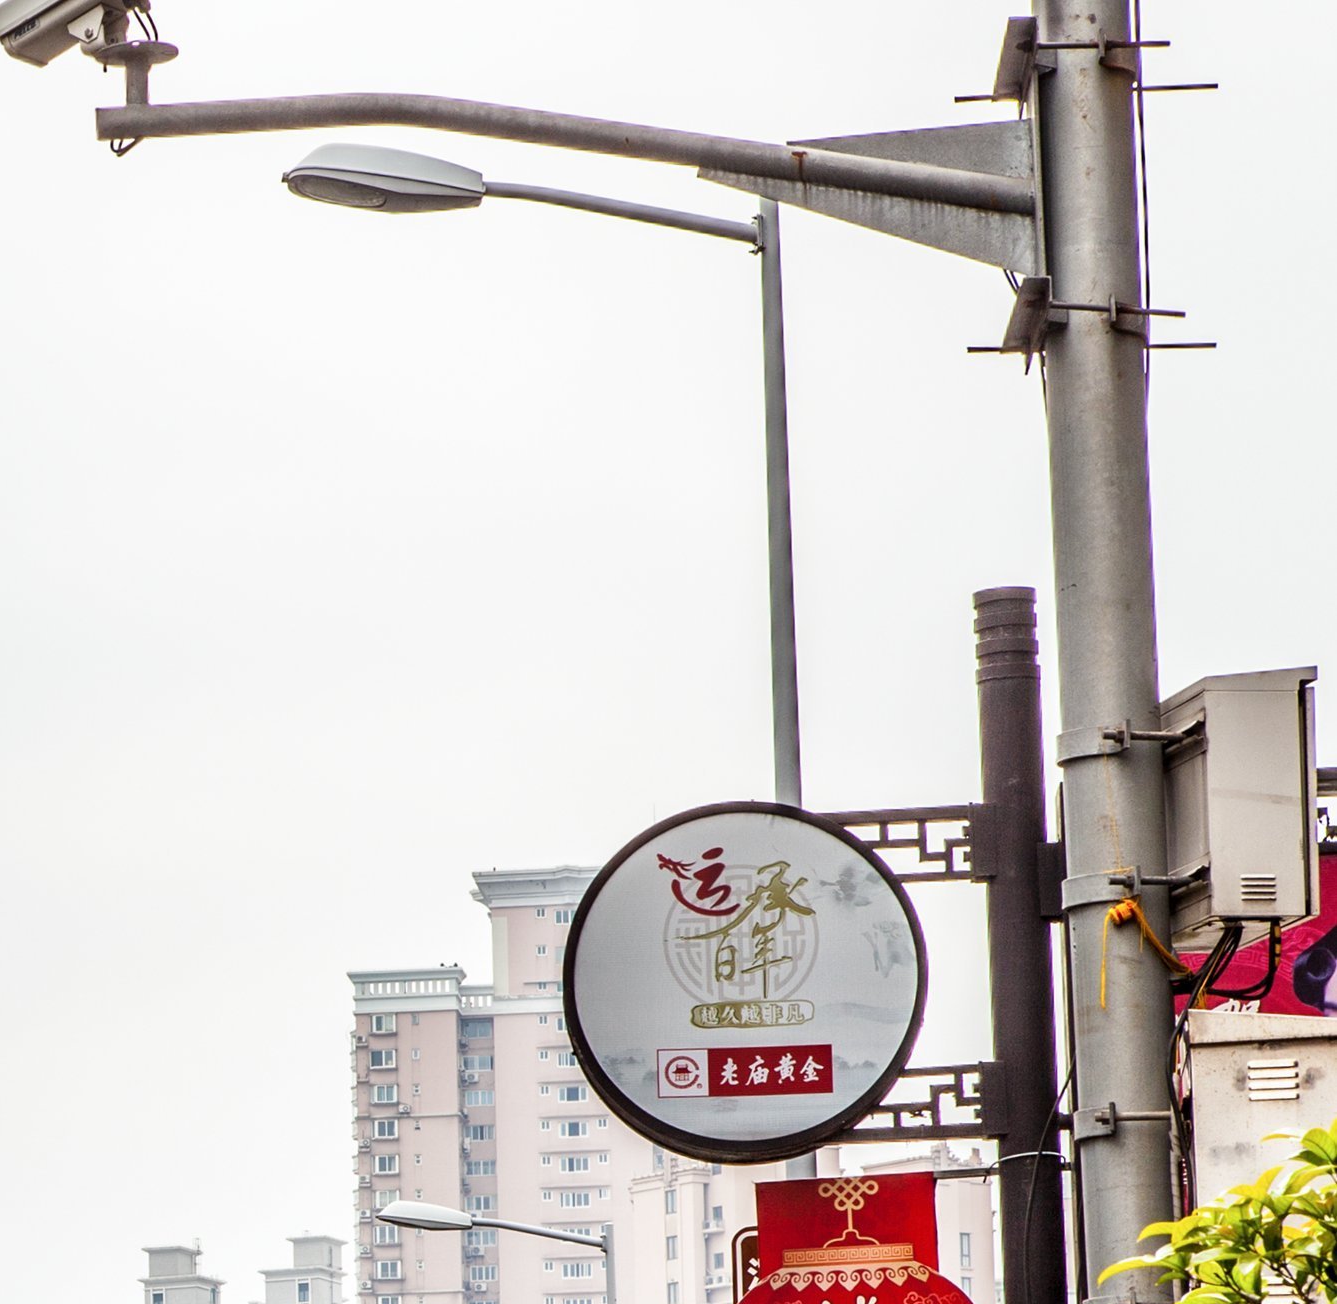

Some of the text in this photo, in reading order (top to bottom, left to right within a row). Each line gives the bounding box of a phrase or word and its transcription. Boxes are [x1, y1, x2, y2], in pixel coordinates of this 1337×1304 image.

[700, 1003, 804, 1025] 越久越非凡
[720, 1053, 824, 1086] 老庙黄金
